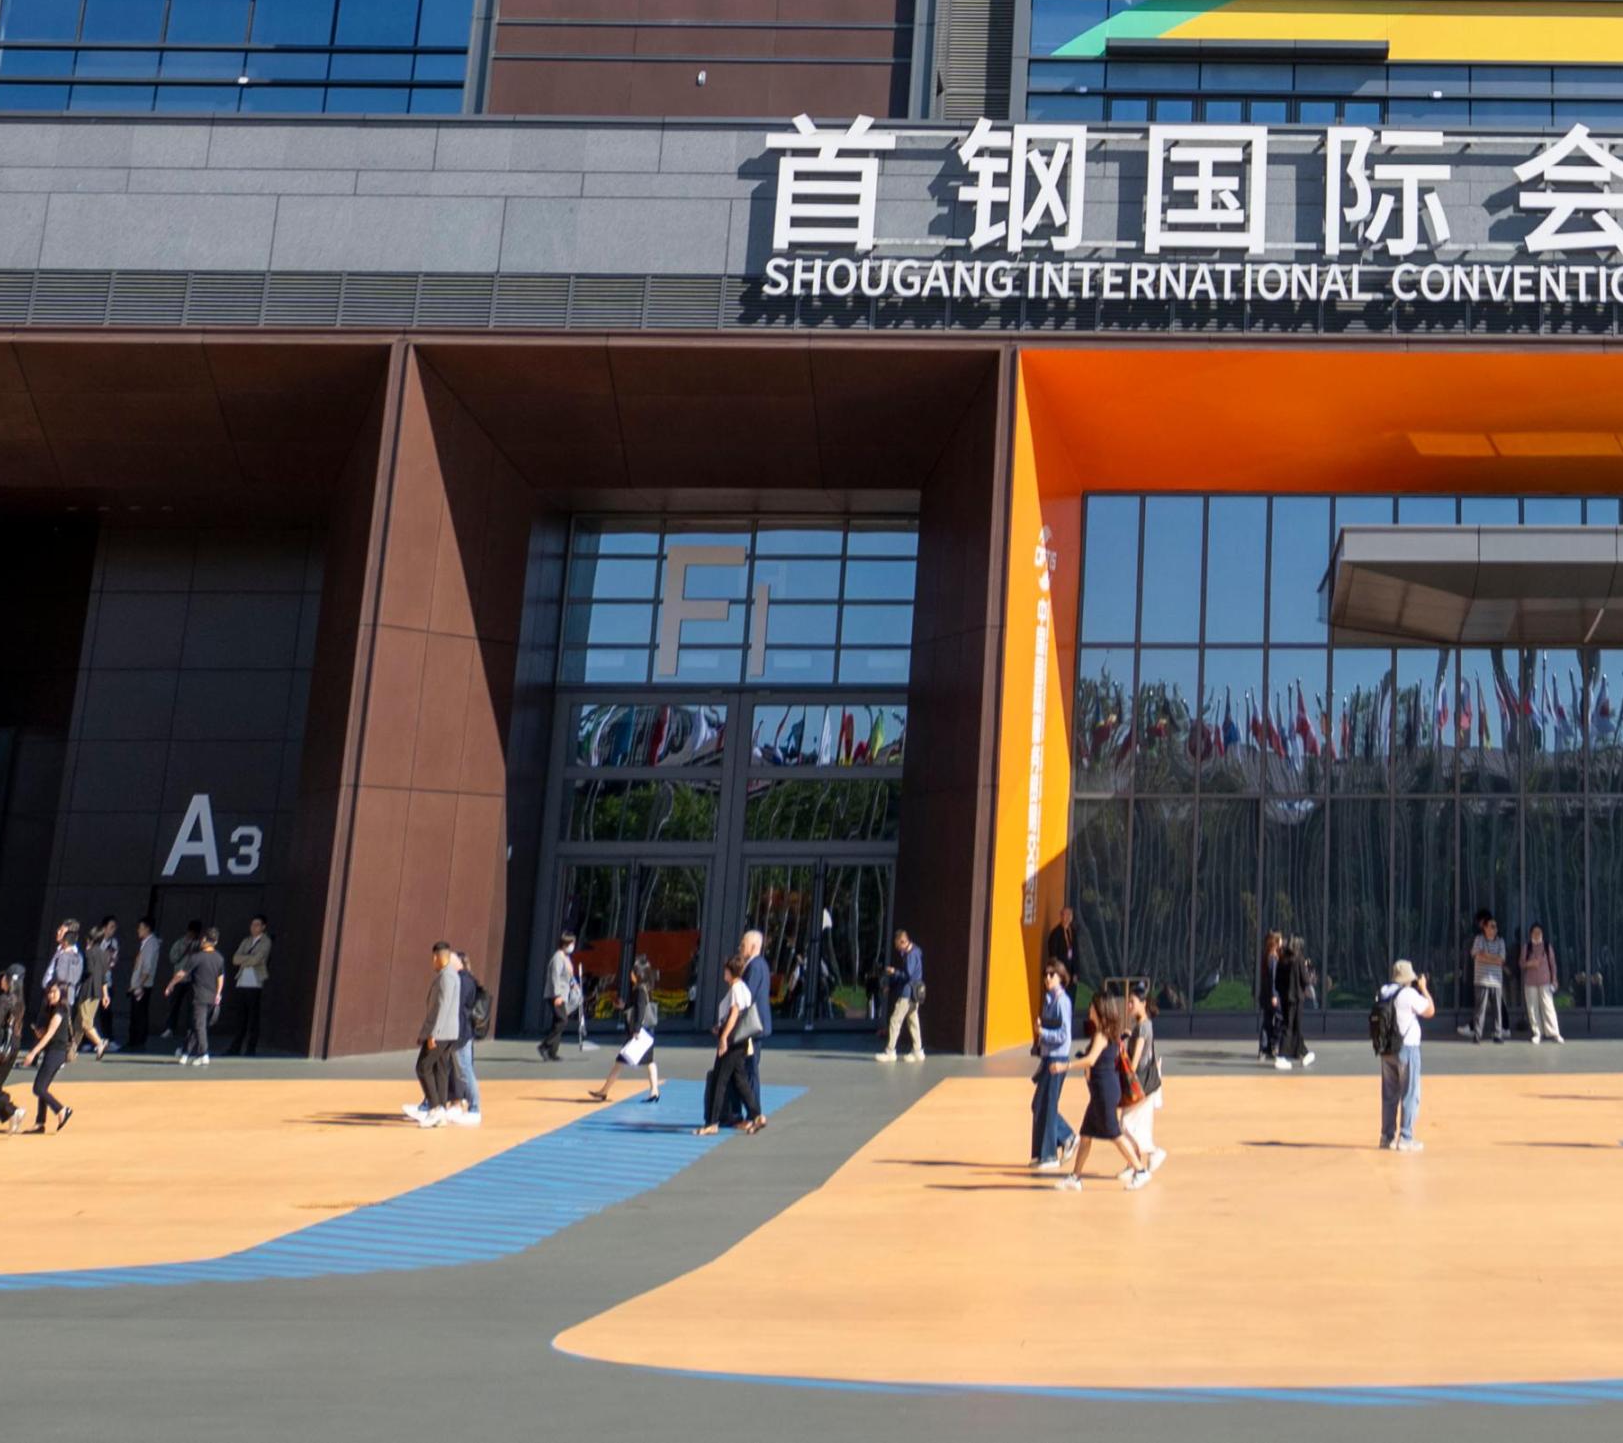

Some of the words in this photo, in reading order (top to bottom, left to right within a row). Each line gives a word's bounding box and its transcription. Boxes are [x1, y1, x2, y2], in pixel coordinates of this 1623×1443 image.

[762, 257, 1015, 299] SHOUGANG
[1027, 260, 1383, 303] INTERNATIONAL
[162, 794, 263, 876] A3
